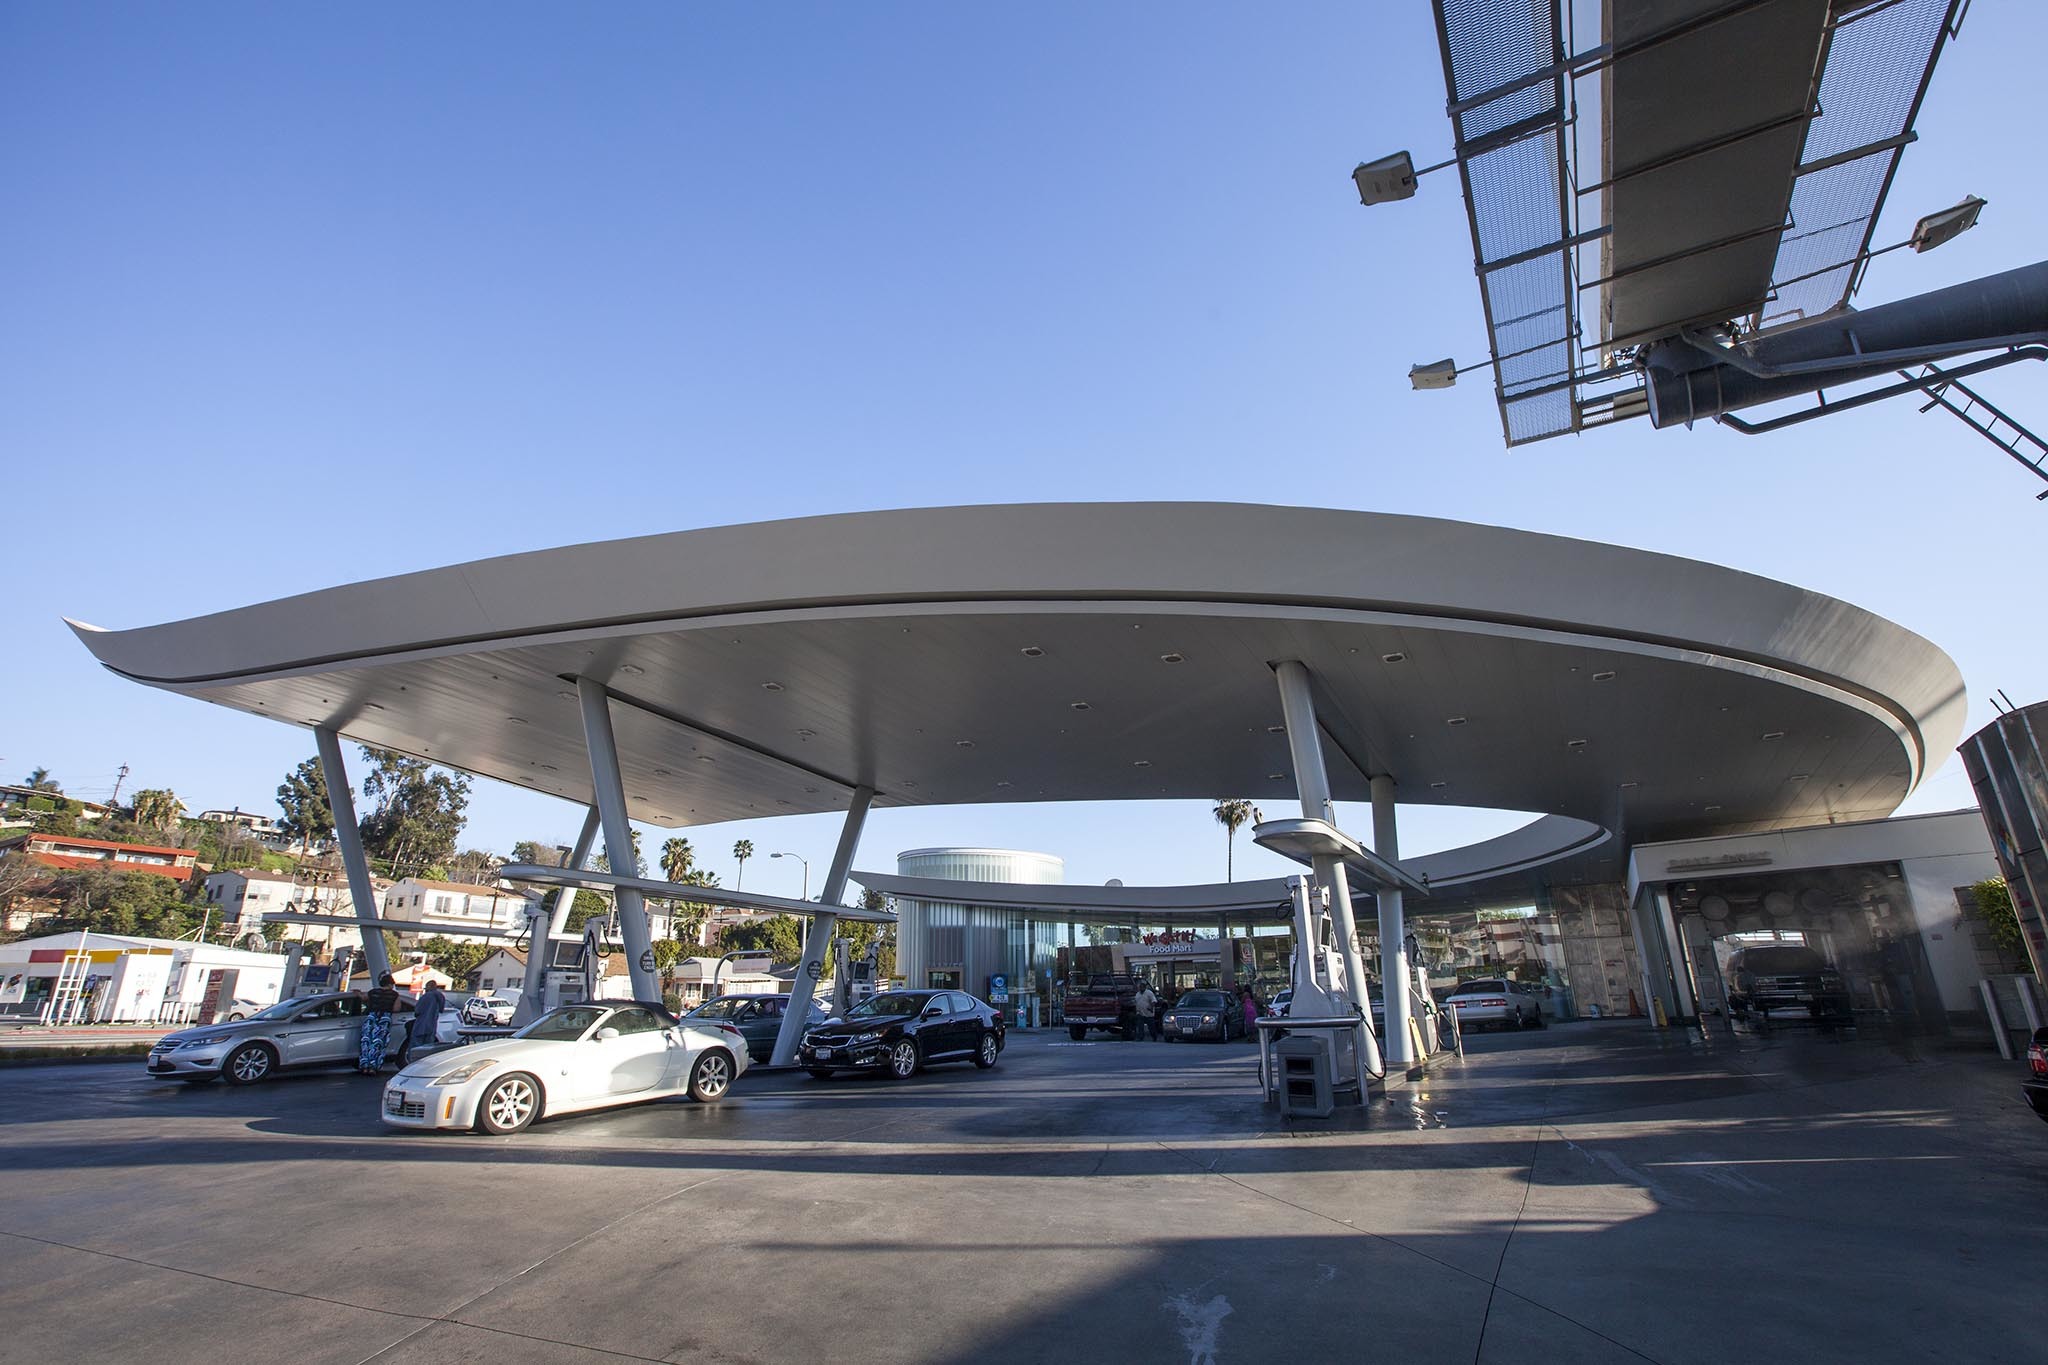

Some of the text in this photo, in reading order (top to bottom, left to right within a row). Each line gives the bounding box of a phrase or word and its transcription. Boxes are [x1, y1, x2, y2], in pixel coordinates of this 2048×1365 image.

[557, 845, 573, 868] 7
[1150, 944, 1192, 953] Food Mart
